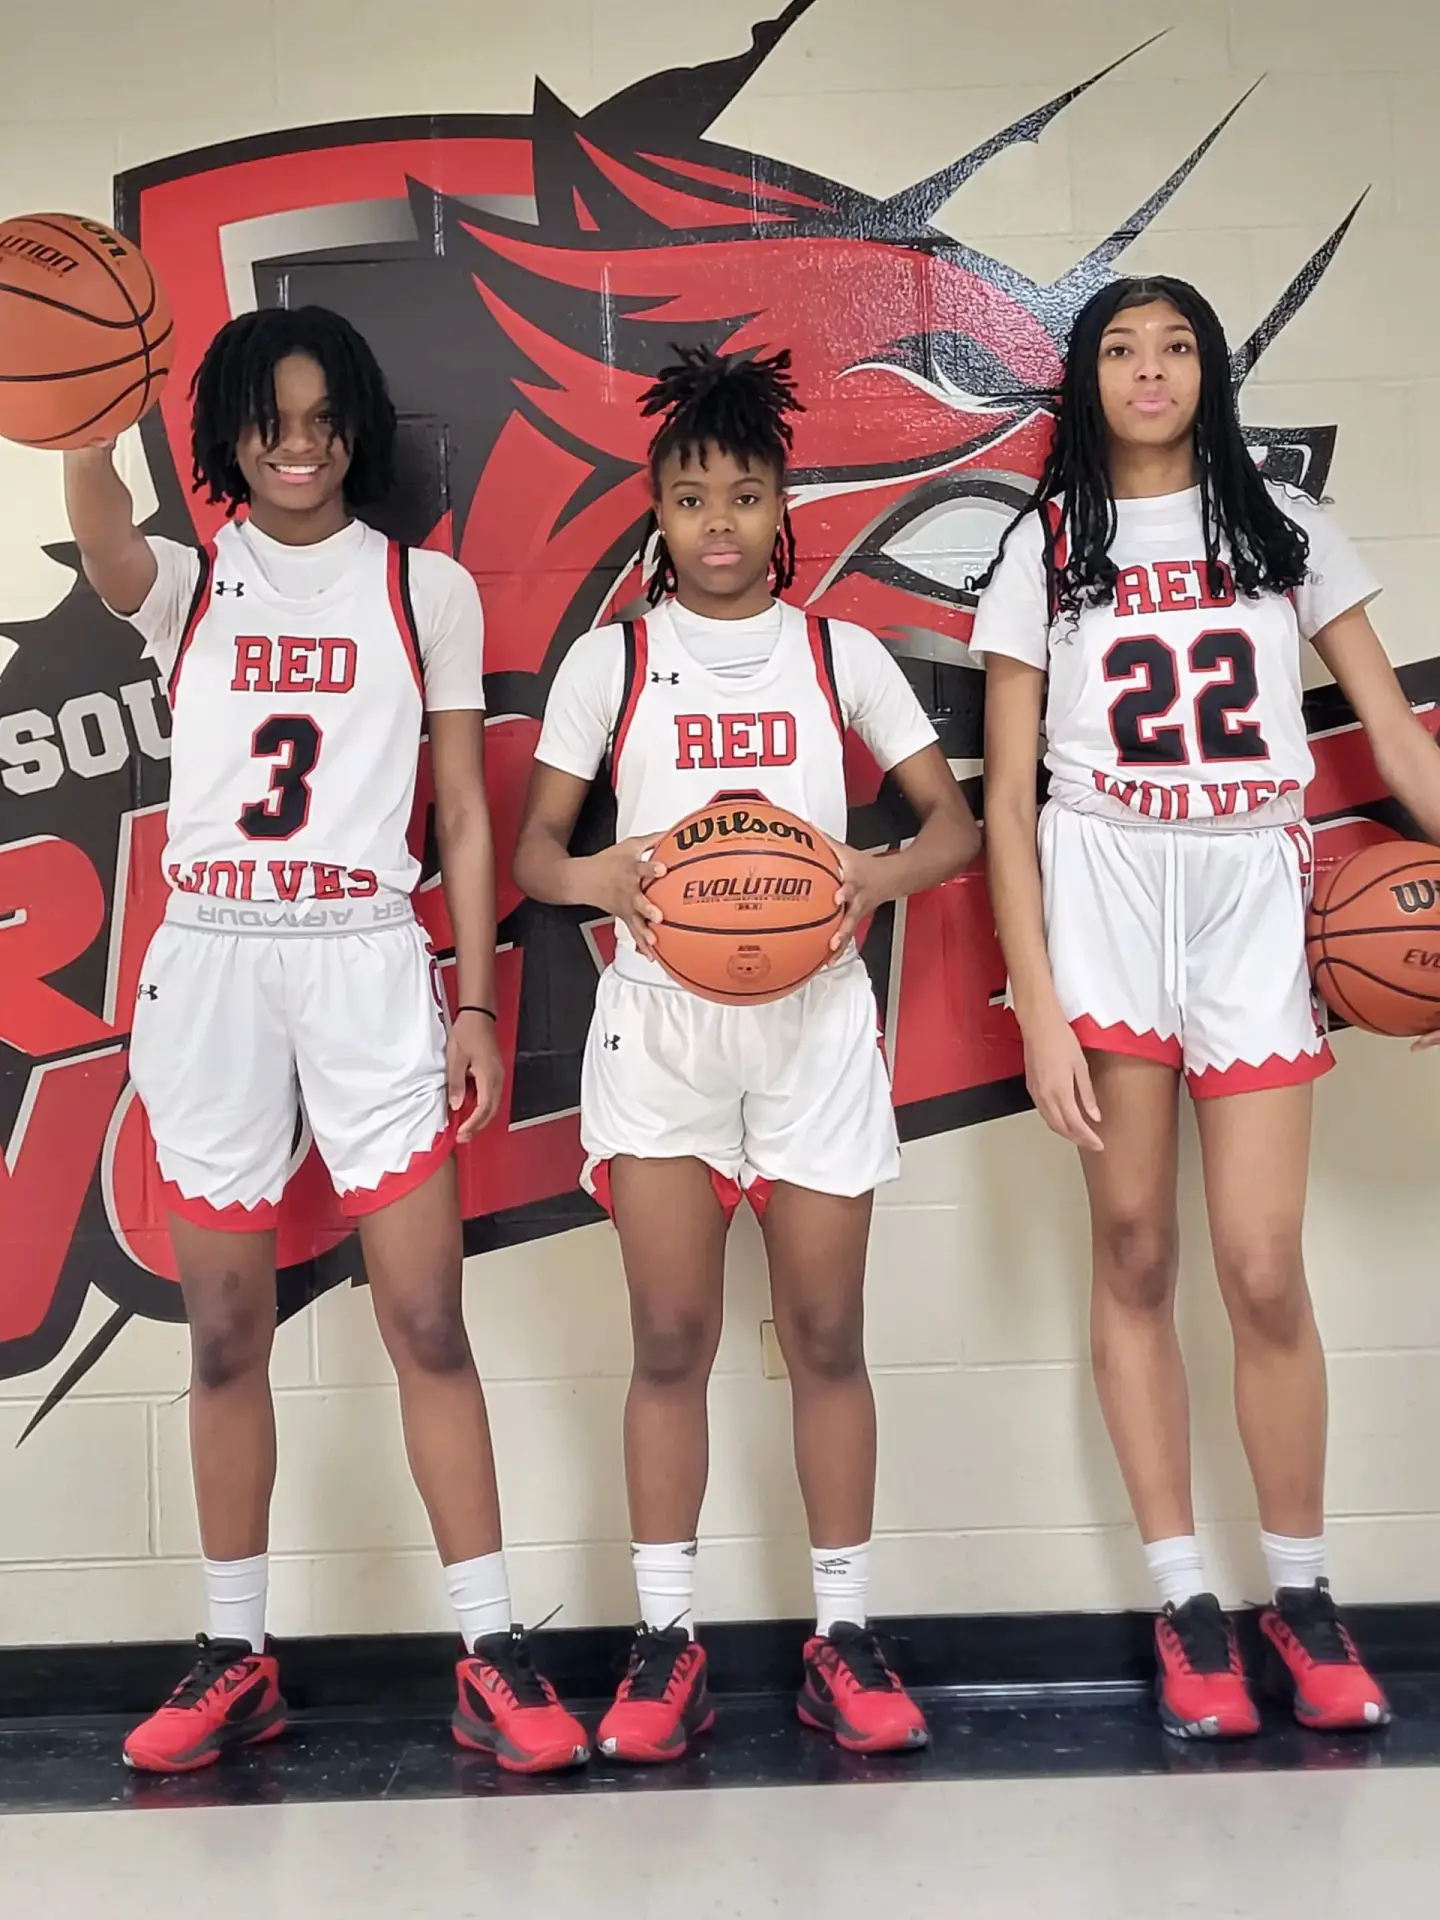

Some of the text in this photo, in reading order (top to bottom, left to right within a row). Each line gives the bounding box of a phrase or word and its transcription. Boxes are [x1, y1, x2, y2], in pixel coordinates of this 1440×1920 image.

[1113, 559, 1238, 618] RED
[230, 635, 358, 694] RED
[1101, 627, 1271, 767] 22
[673, 710, 797, 770] RED
[235, 713, 324, 842] 3
[672, 811, 816, 852] Wilson
[167, 859, 379, 903] WOLVES
[682, 876, 814, 899] EVOLUTION
